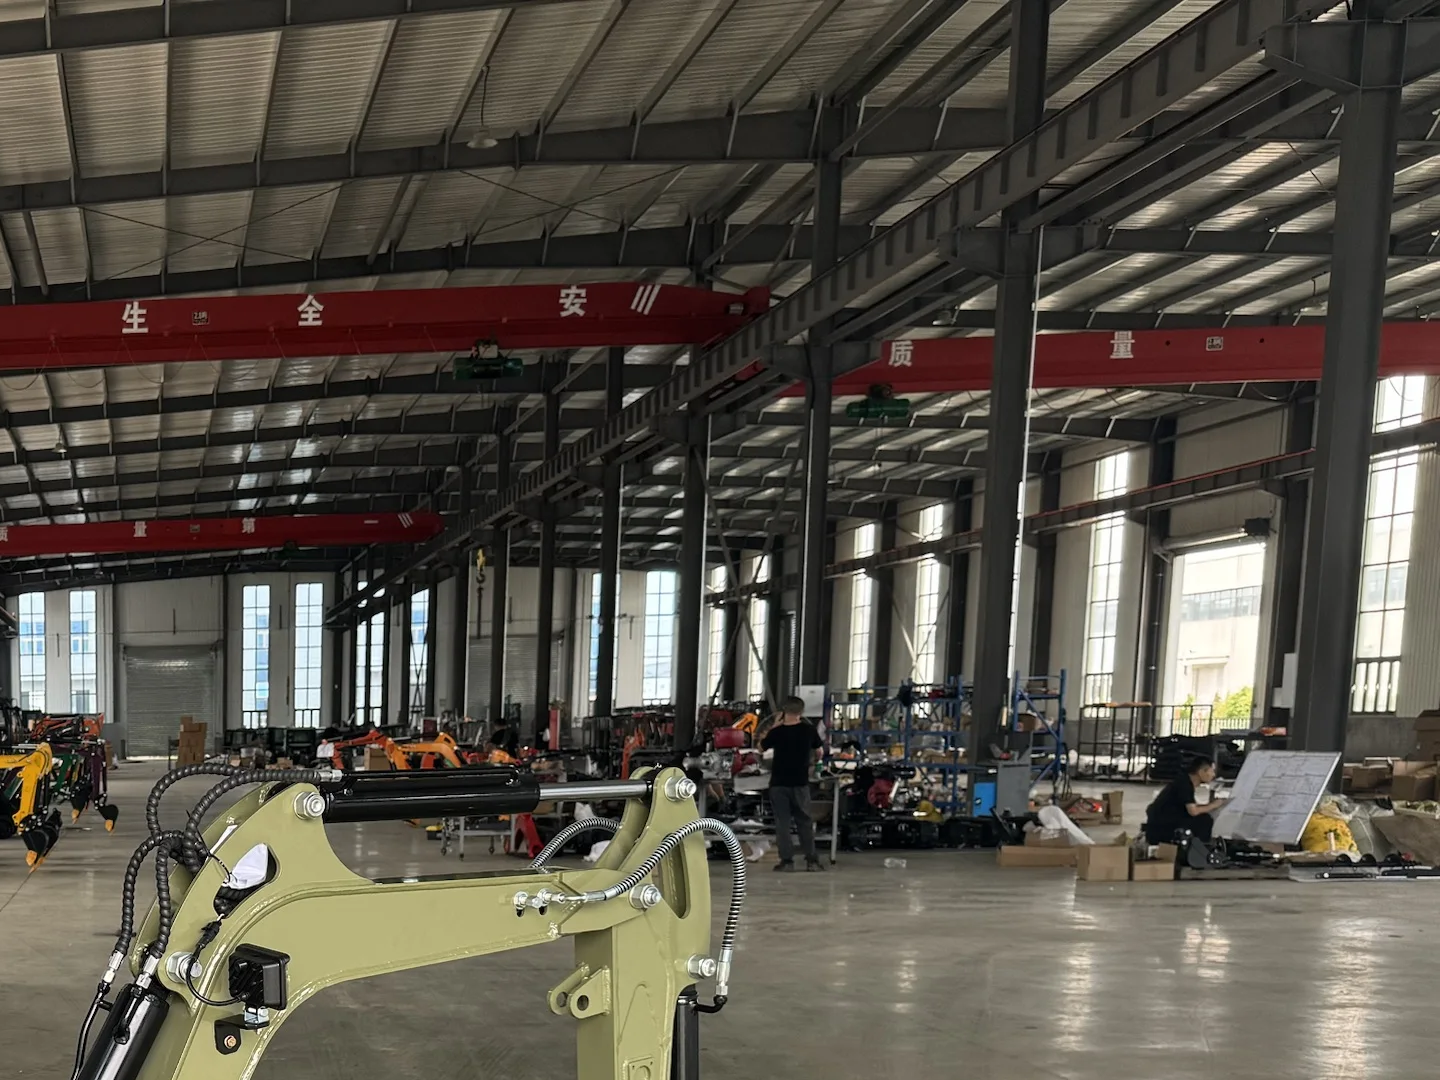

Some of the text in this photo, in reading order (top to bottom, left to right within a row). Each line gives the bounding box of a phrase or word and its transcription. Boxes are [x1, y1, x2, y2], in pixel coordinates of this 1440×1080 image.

[122, 301, 148, 333] 生
[298, 295, 324, 327] 全
[559, 285, 588, 317] 安
[888, 331, 1135, 367] 质 量
